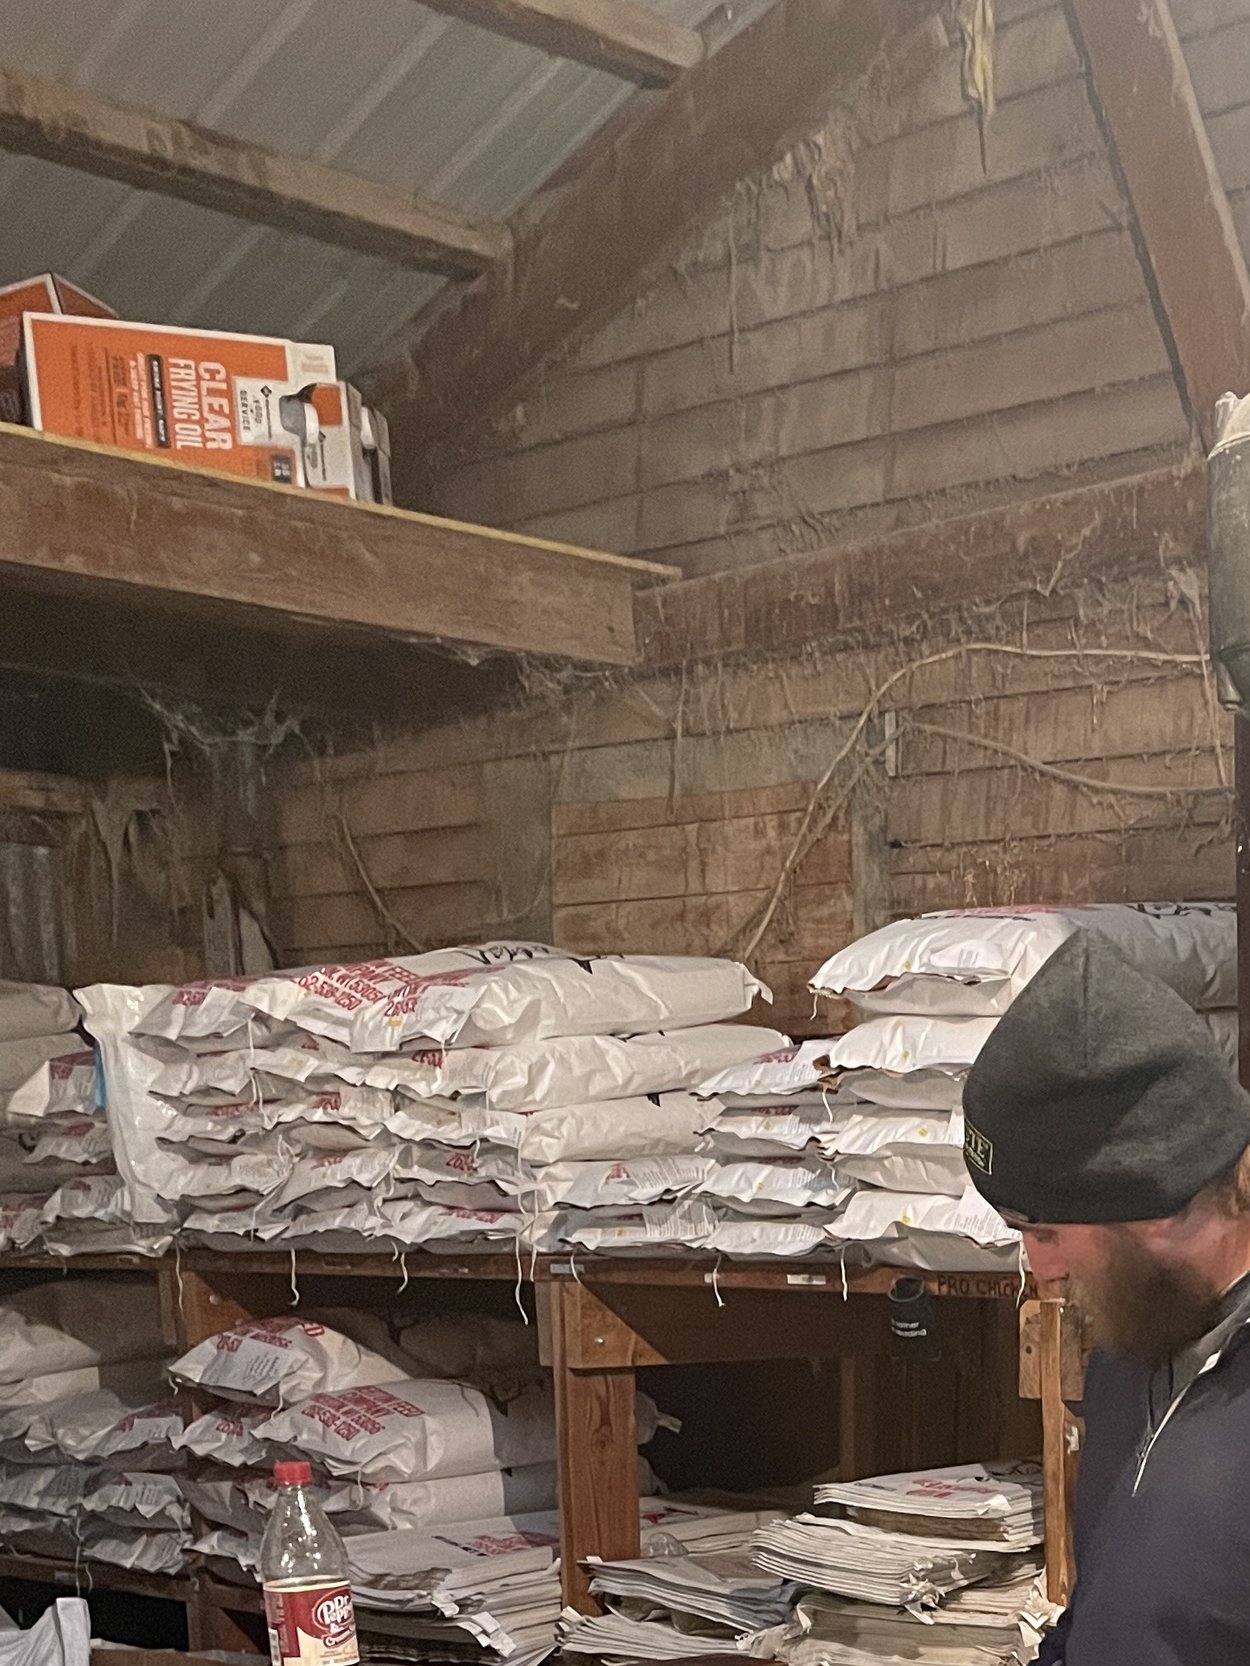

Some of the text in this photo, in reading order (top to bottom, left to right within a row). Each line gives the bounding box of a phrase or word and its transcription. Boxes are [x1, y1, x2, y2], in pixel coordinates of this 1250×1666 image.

[168, 357, 203, 450] FRYING OIL
[198, 361, 233, 450] CLEAR
[317, 1600, 353, 1625] Pepp
